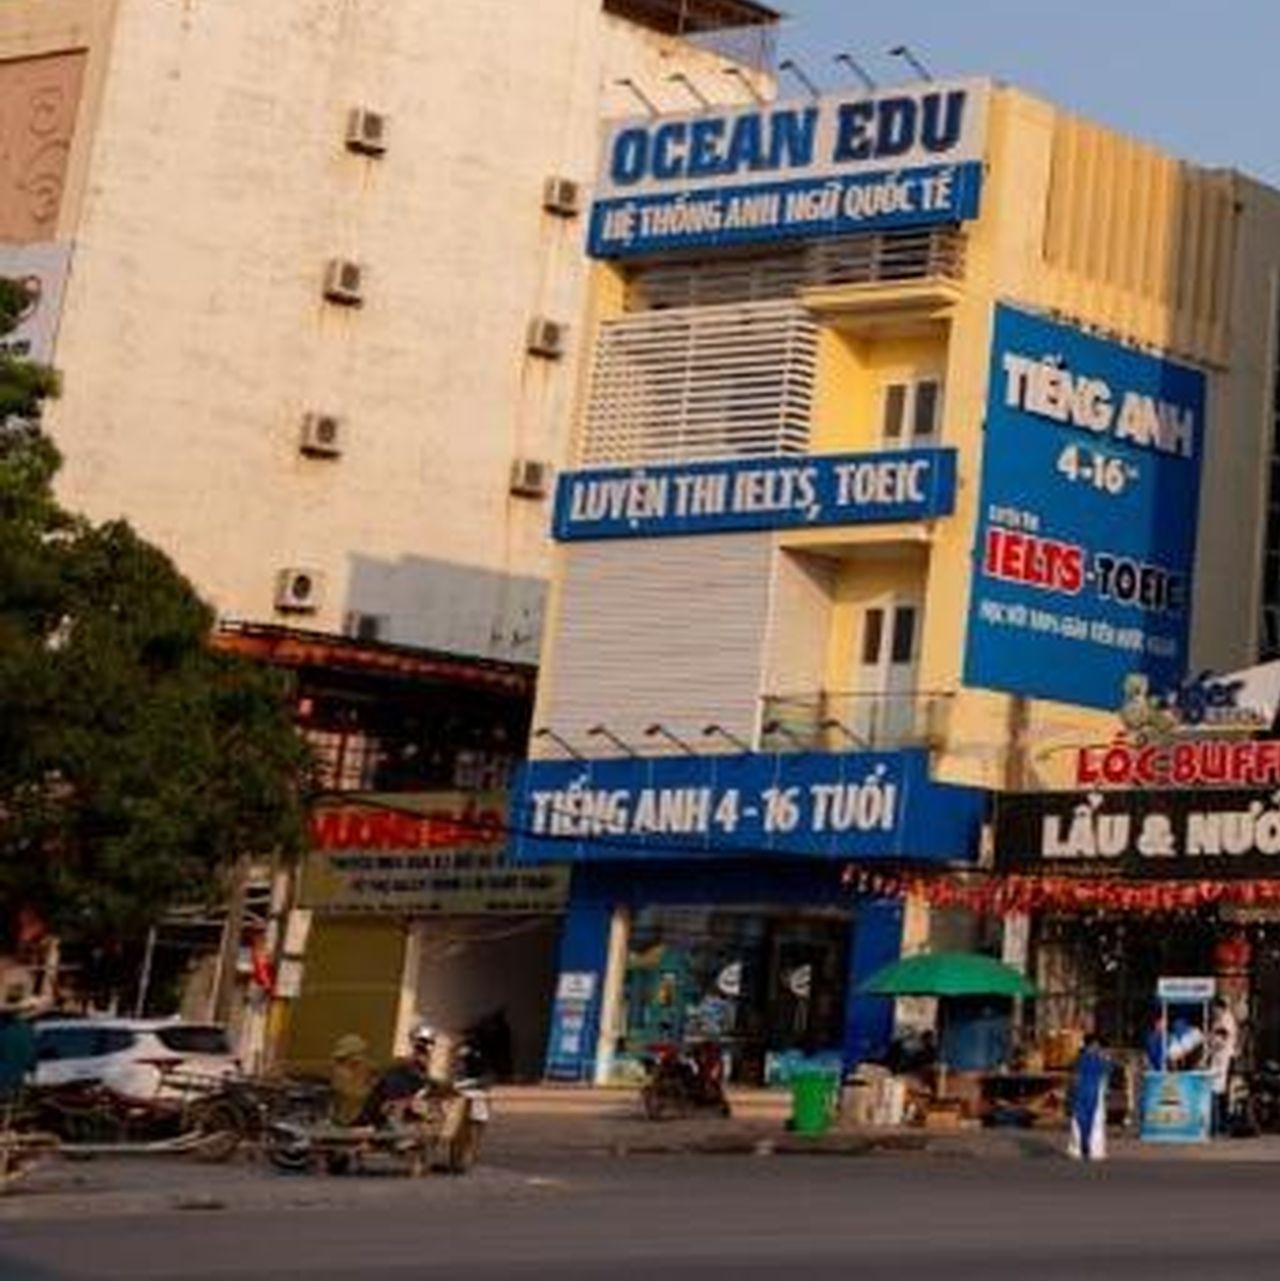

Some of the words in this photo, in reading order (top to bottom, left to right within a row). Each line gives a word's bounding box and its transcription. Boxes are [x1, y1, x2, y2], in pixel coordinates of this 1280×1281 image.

[611, 108, 818, 186] OCEAN
[834, 91, 967, 162] EDU
[602, 203, 636, 247] HỆ
[640, 192, 721, 238] THỐNG
[724, 194, 780, 231] ANH
[845, 171, 916, 219] QUỐC
[921, 168, 954, 210] TẾ
[1003, 352, 1114, 432] TIẾNG
[1115, 391, 1194, 458] ANH
[570, 466, 668, 530] LUYỆN
[674, 471, 730, 516] THI
[835, 460, 931, 506] TOEIC
[532, 774, 630, 838] TIẾNG
[631, 789, 709, 834] ANH
[716, 788, 740, 834] 4
[761, 788, 799, 834] 16
[811, 762, 898, 832] TUỔI
[1137, 813, 1177, 858] &
